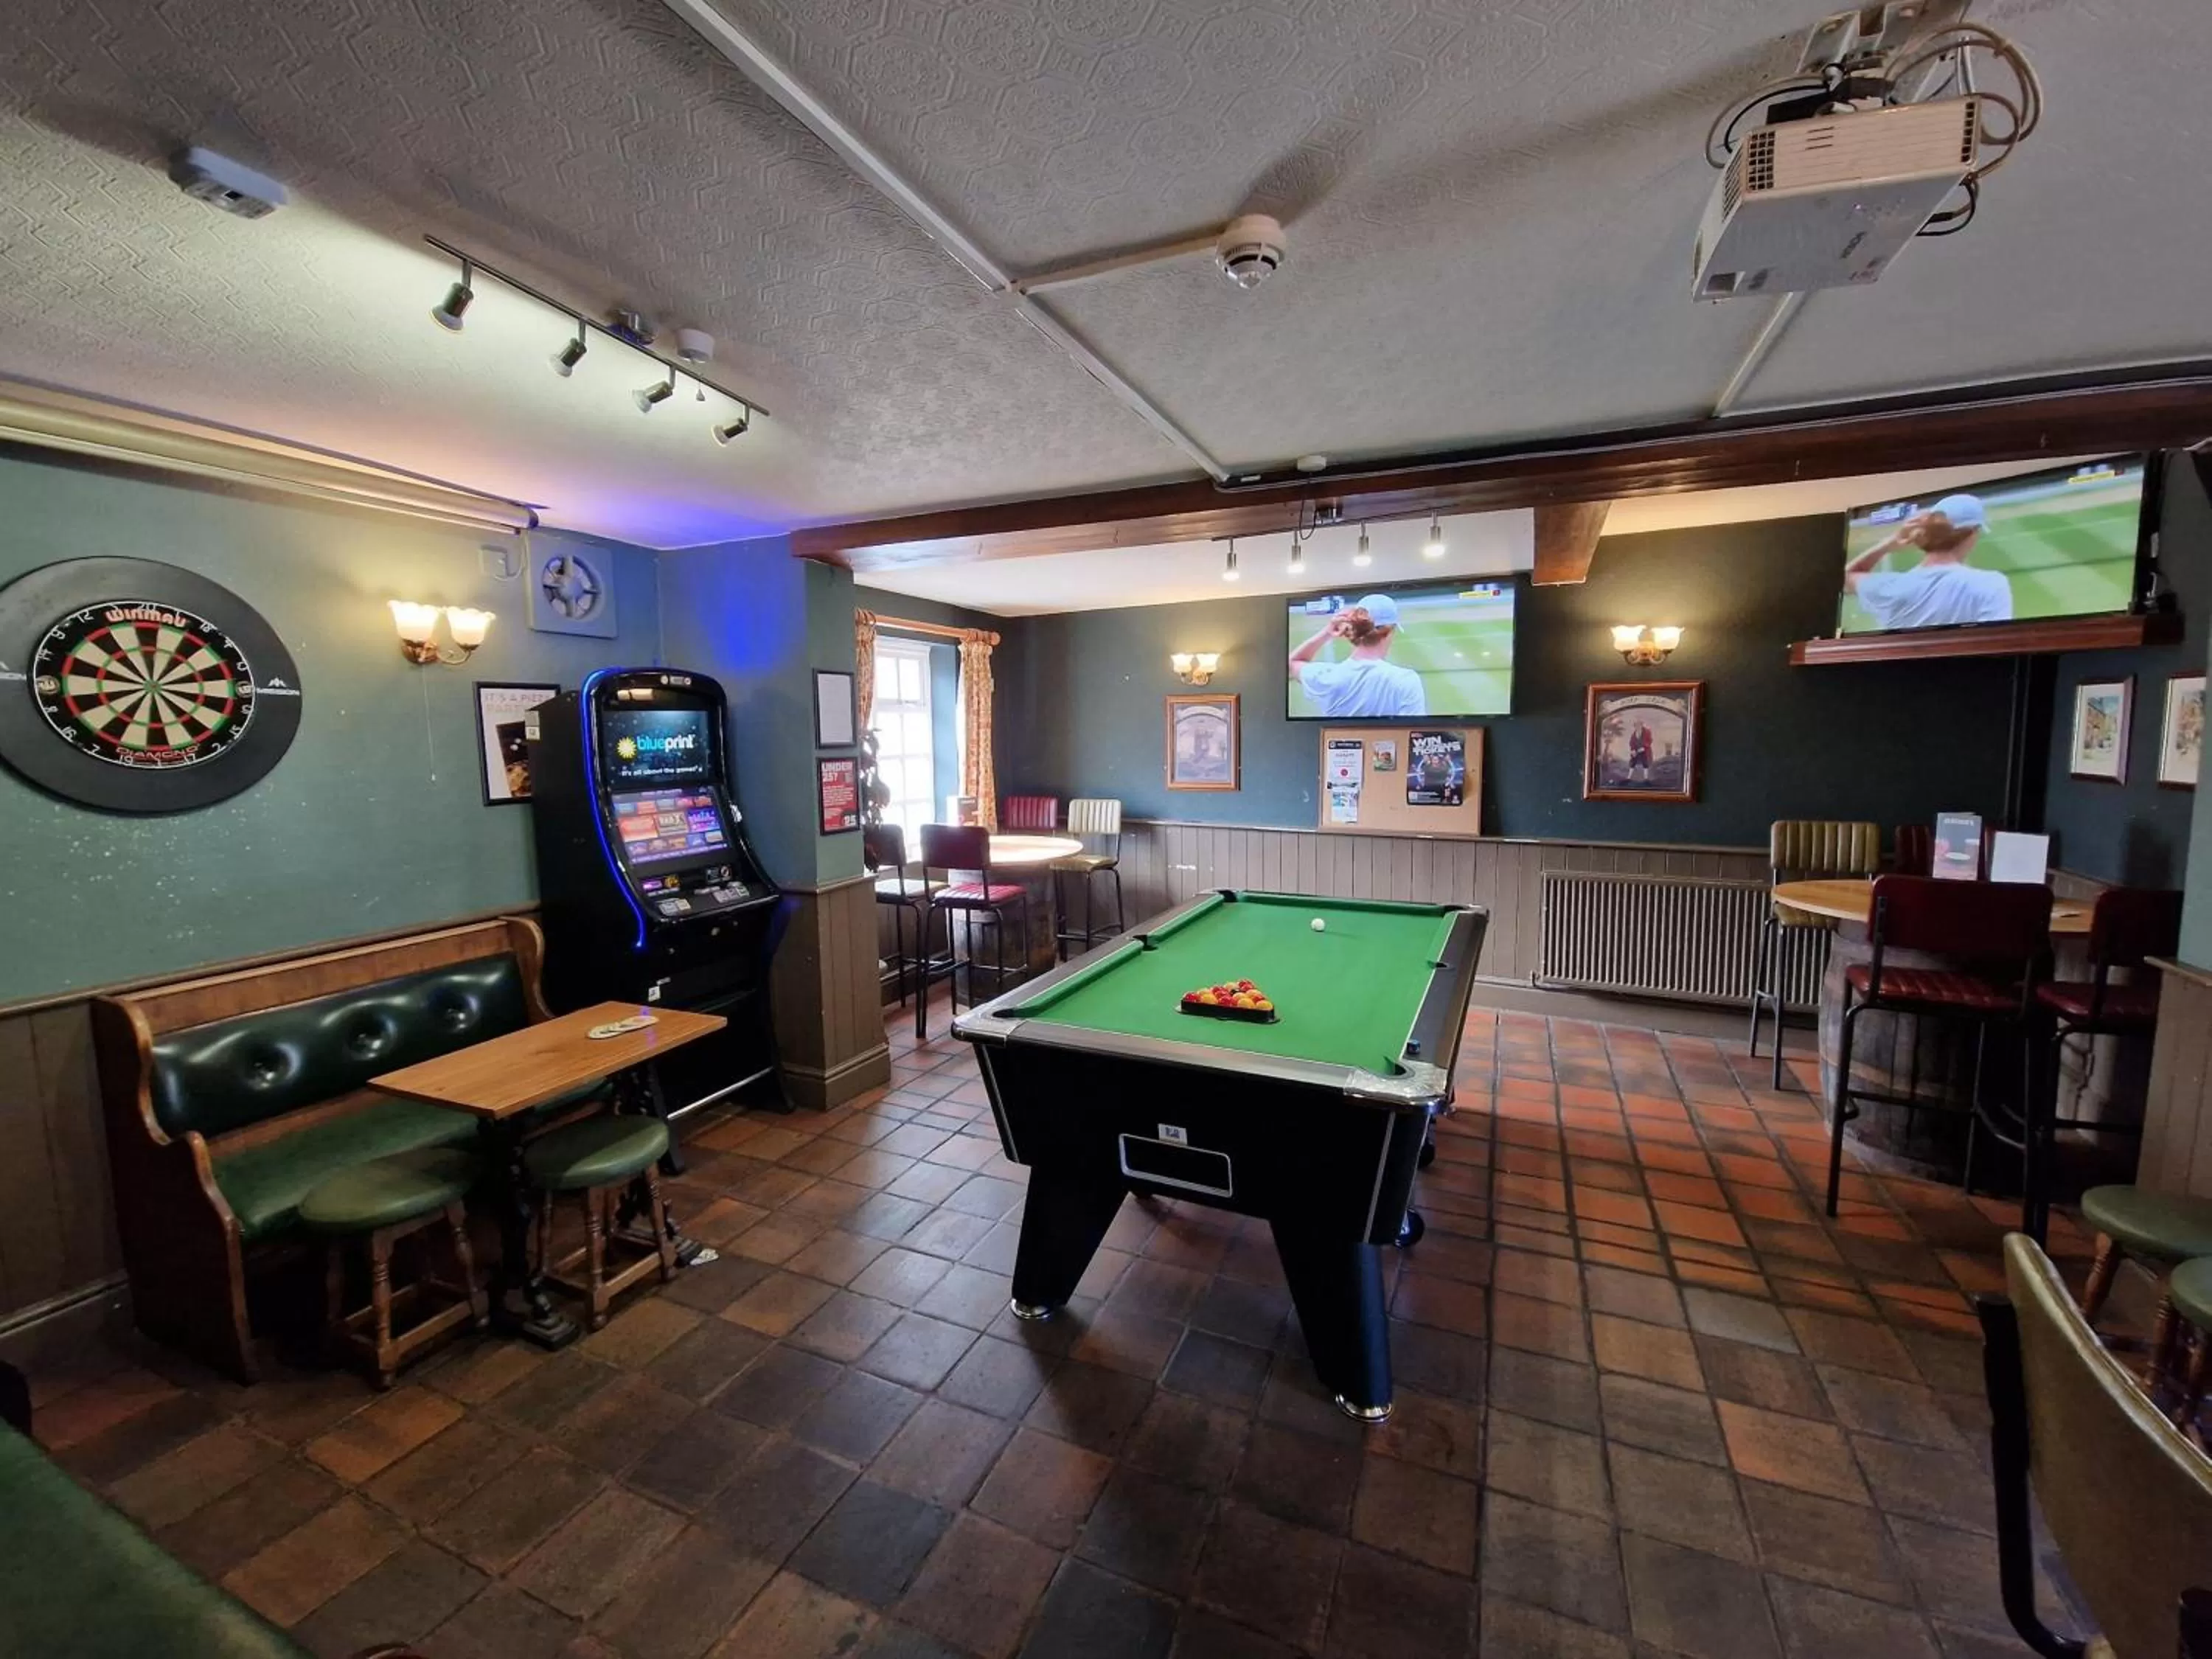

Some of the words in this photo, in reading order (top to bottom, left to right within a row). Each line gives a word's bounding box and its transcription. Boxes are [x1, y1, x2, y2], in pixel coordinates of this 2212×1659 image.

[637, 734, 695, 753] blueprint
[1412, 735, 1441, 748] WIN
[116, 744, 199, 759] DIAMOND
[821, 761, 852, 772] UNDER
